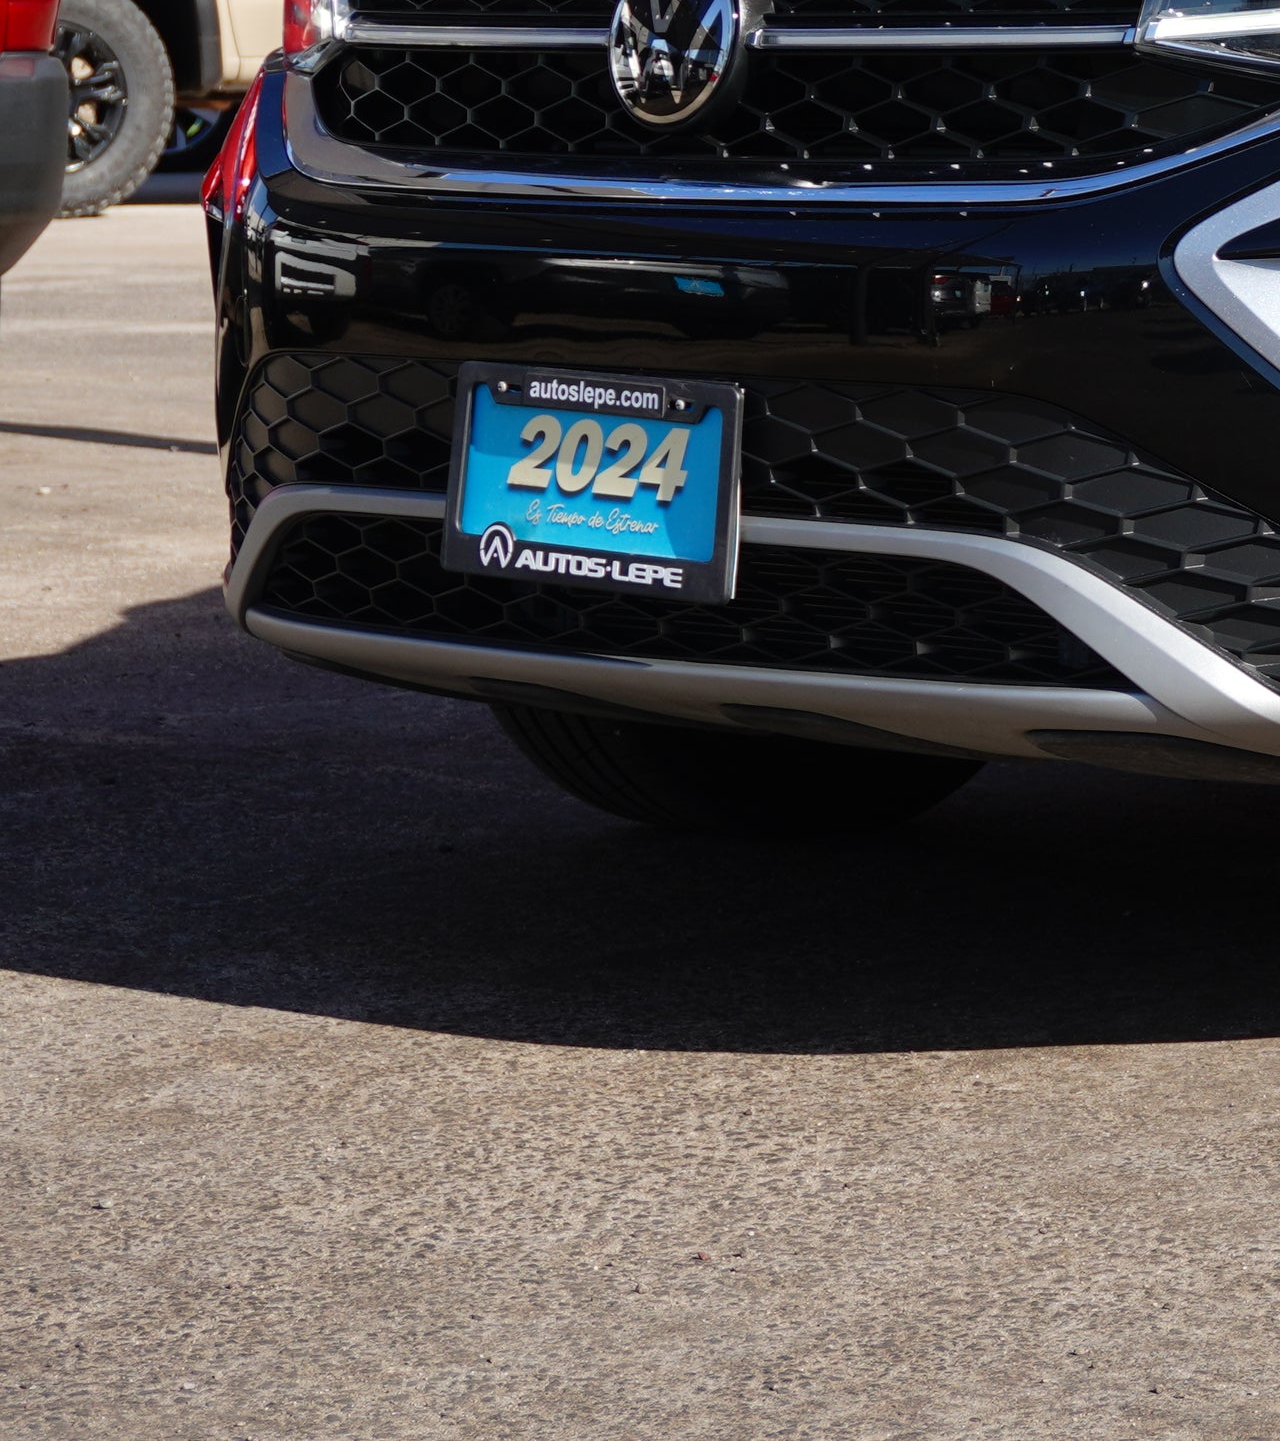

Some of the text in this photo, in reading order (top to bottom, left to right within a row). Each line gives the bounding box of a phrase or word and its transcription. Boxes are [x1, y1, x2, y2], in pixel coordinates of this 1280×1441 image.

[529, 378, 659, 410] autoslepe.com
[506, 414, 691, 502] 2024
[588, 511, 604, 528] de
